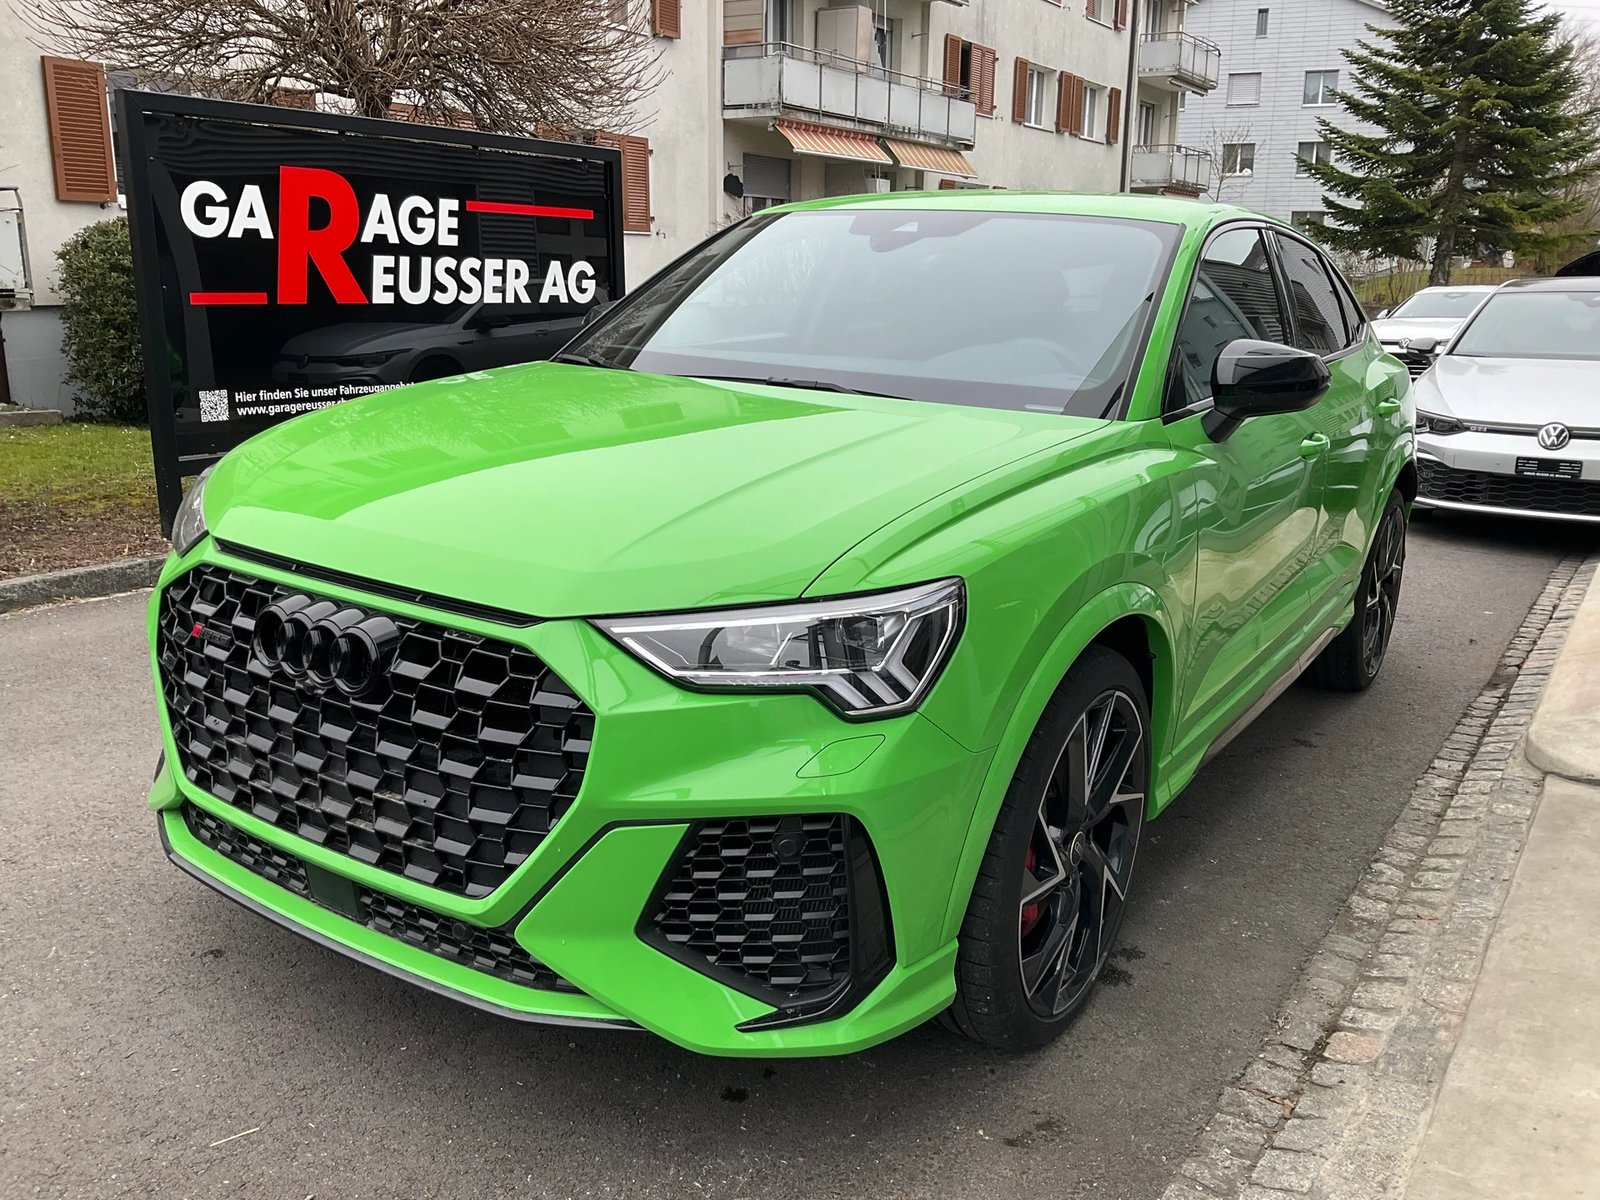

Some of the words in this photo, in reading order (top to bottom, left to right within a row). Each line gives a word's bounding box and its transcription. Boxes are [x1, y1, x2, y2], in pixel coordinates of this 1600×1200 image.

[180, 165, 459, 304] GARAGE
[539, 261, 597, 304] AG
[235, 391, 257, 402] Hier
[259, 389, 292, 401] finden
[294, 387, 309, 398] Sie
[311, 388, 338, 397] unser
